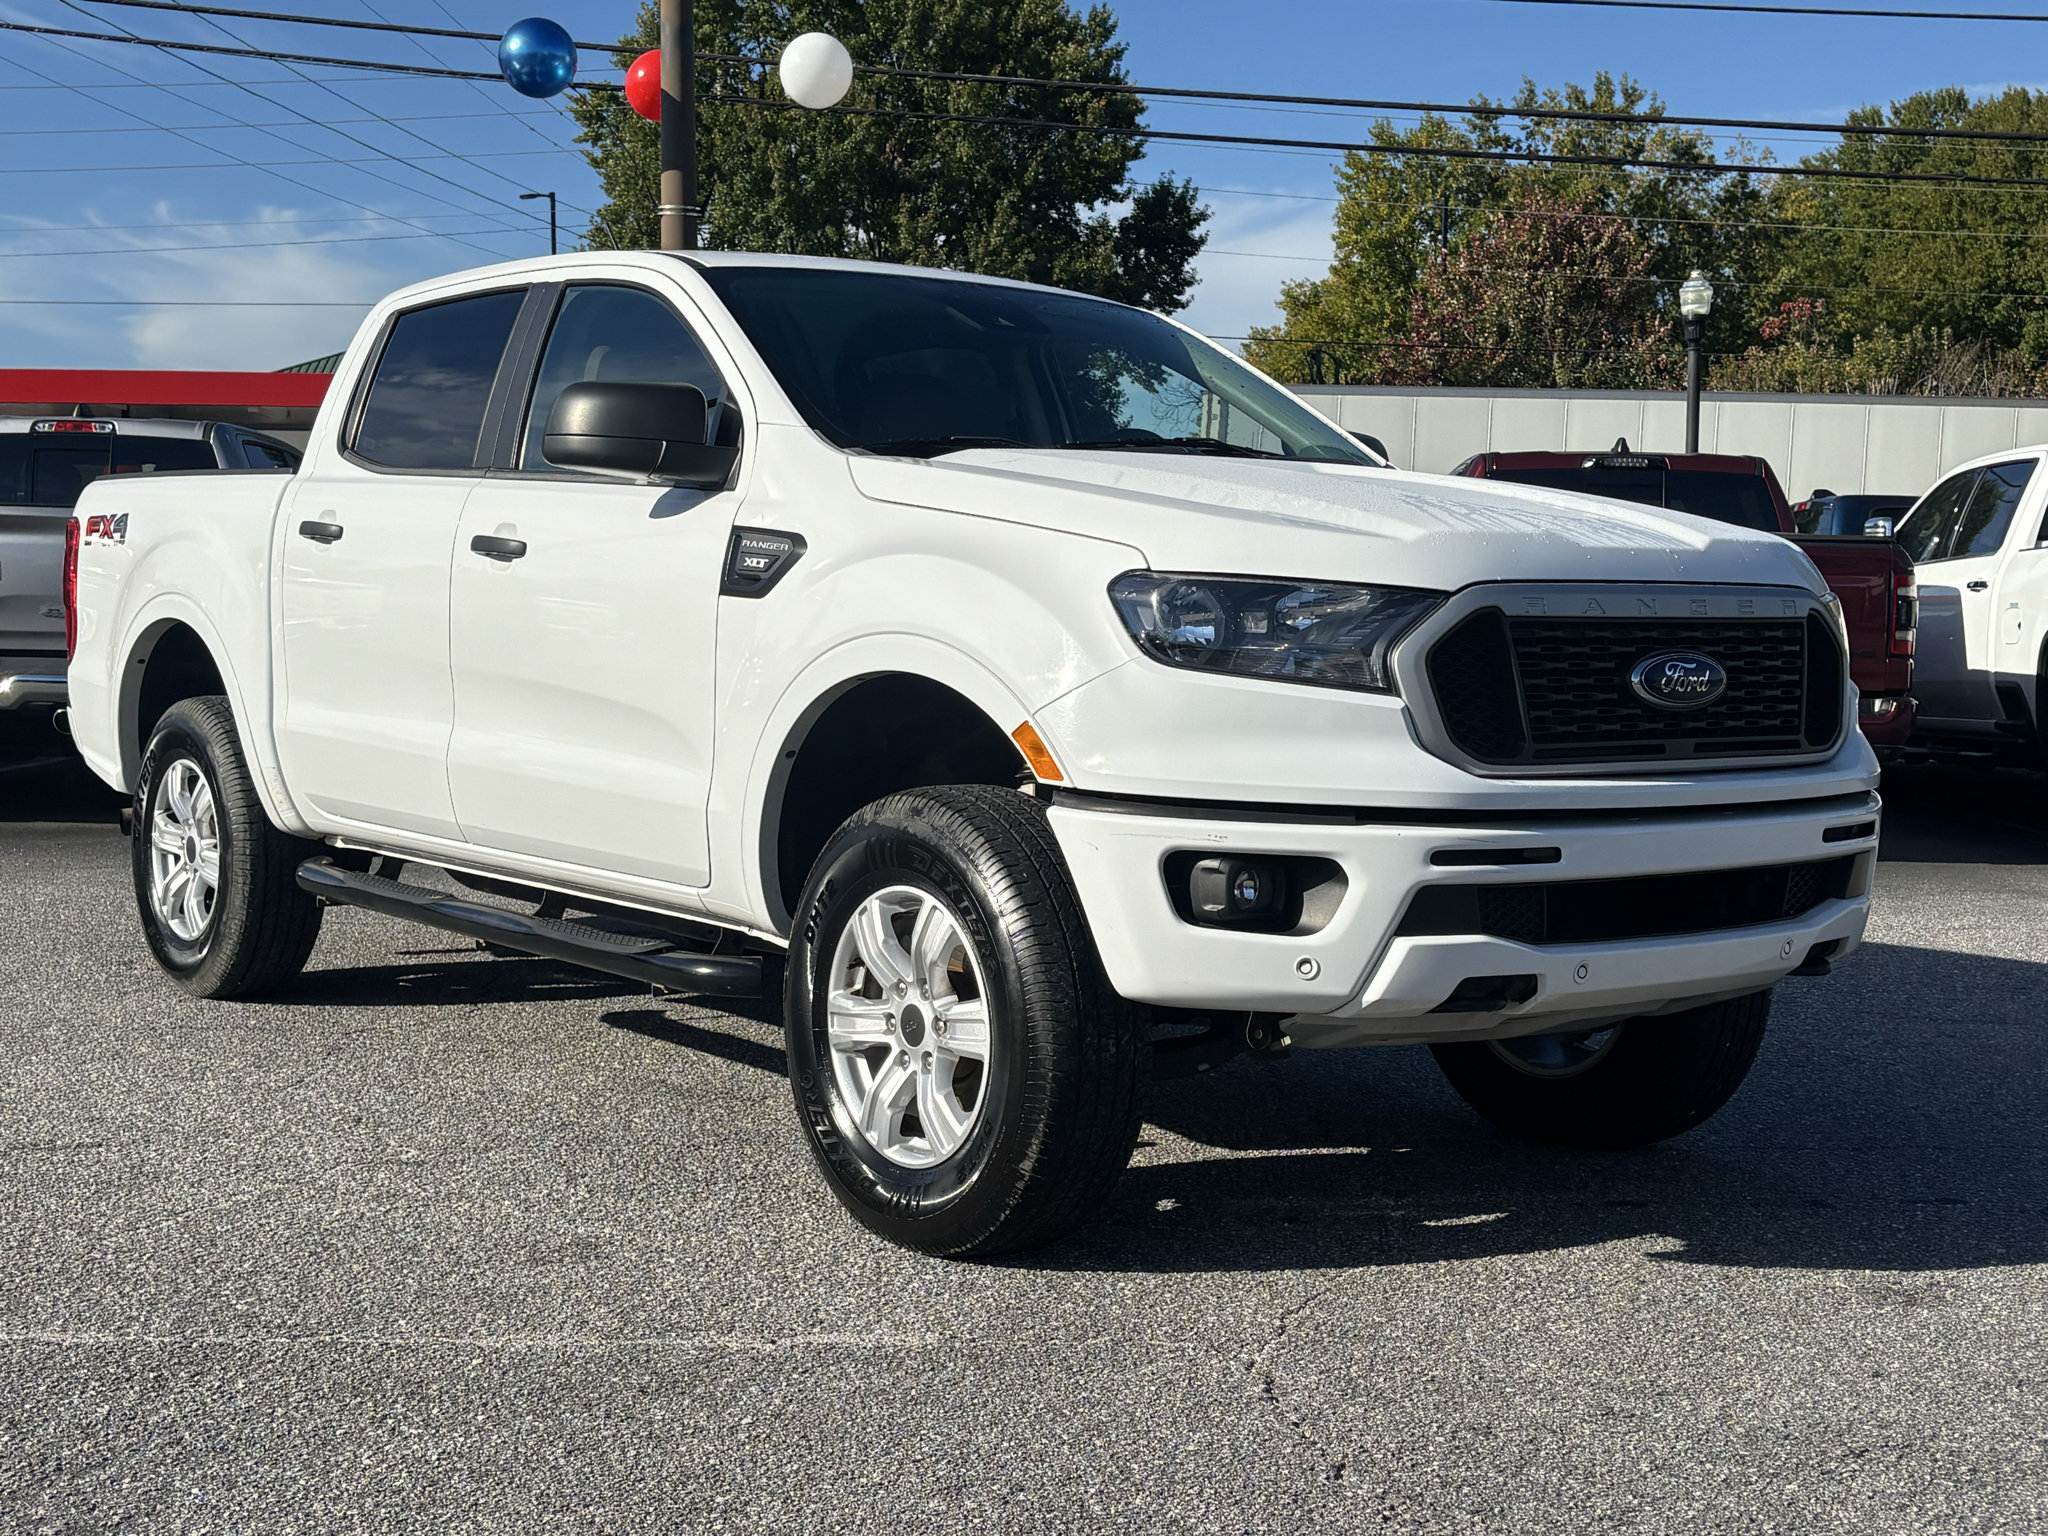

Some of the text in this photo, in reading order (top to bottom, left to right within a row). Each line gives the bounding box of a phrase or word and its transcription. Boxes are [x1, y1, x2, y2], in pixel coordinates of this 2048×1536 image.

[86, 512, 129, 539] FX4
[742, 539, 789, 551] RANGER
[743, 557, 769, 568] XLT
[1521, 596, 1798, 616] RANGER
[1661, 661, 1710, 692] Ford
